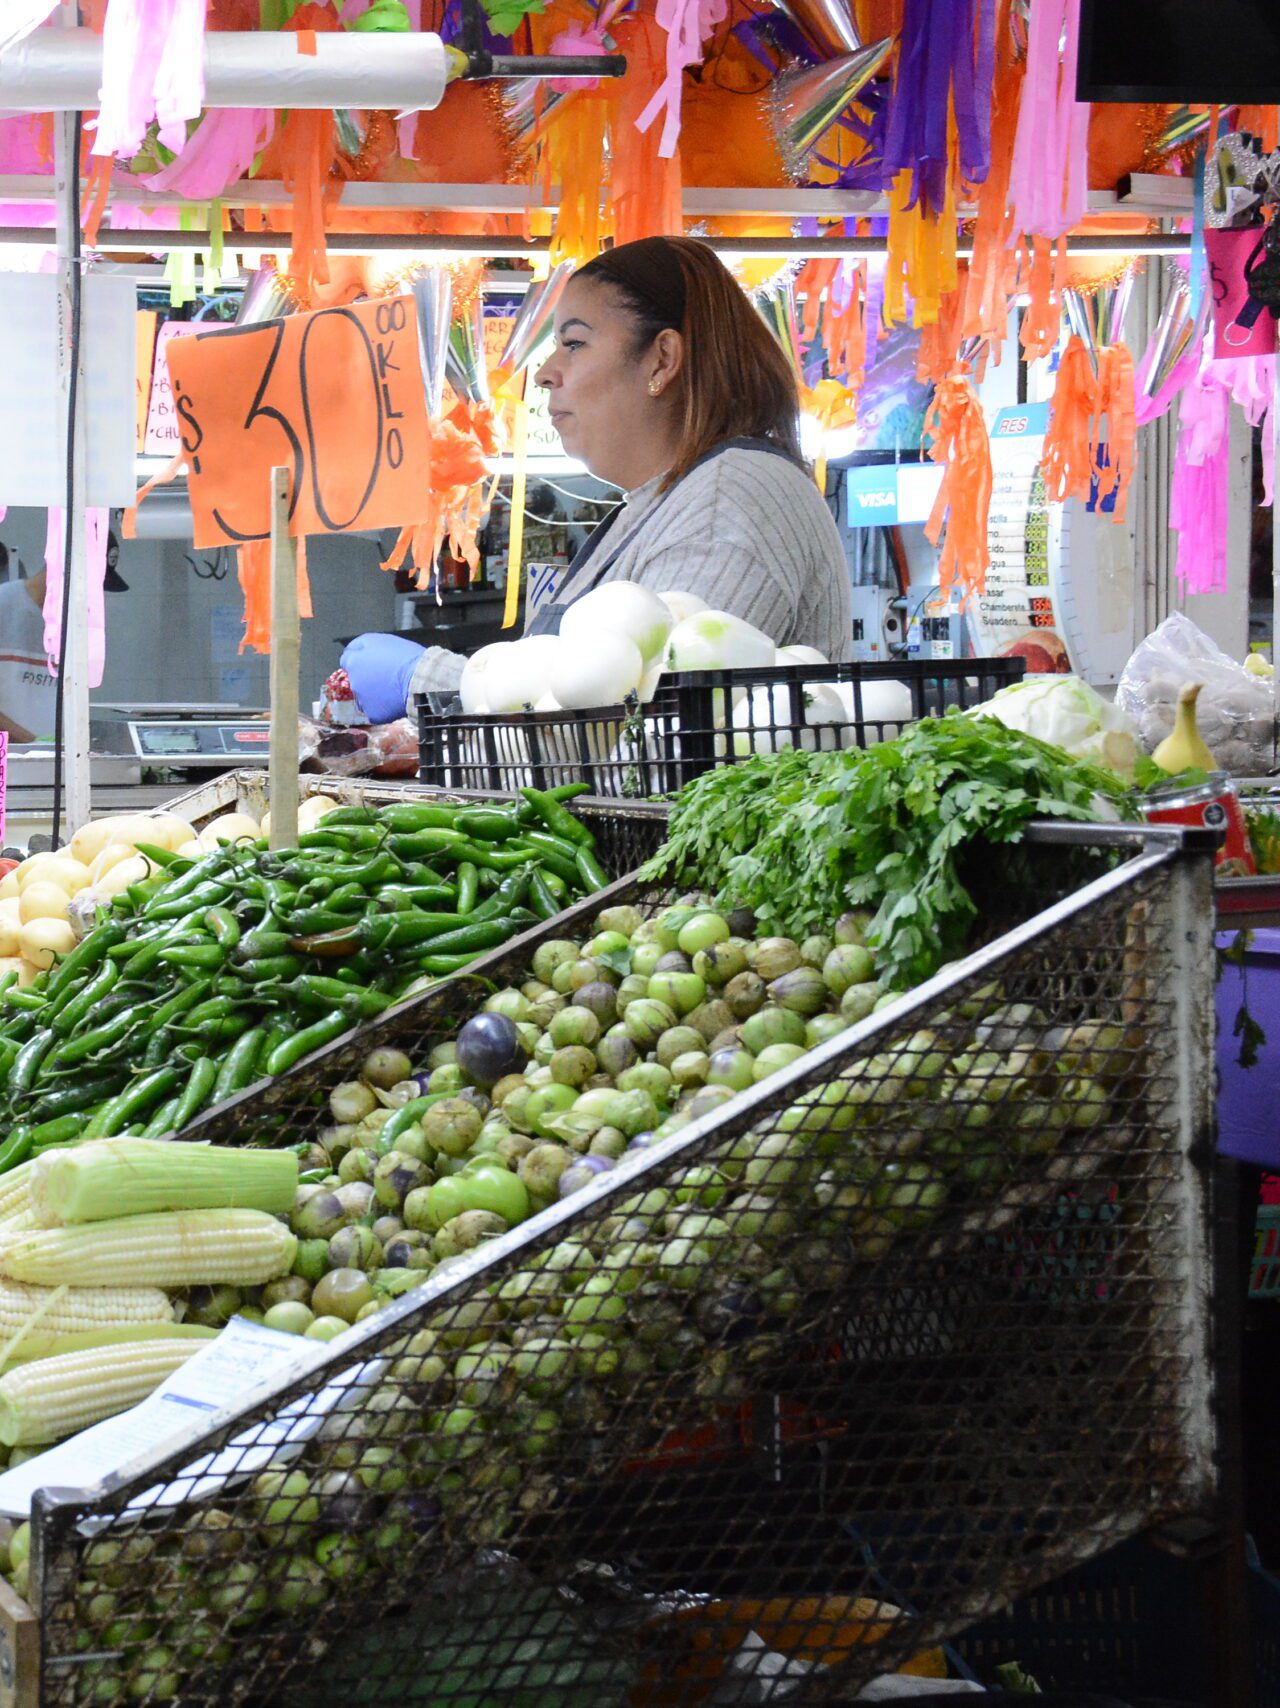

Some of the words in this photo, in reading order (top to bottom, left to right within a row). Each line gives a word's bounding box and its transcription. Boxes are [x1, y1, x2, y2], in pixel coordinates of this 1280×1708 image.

[998, 417, 1029, 434] RES
[856, 491, 897, 508] VISA
[982, 616, 1018, 625] Suadero
